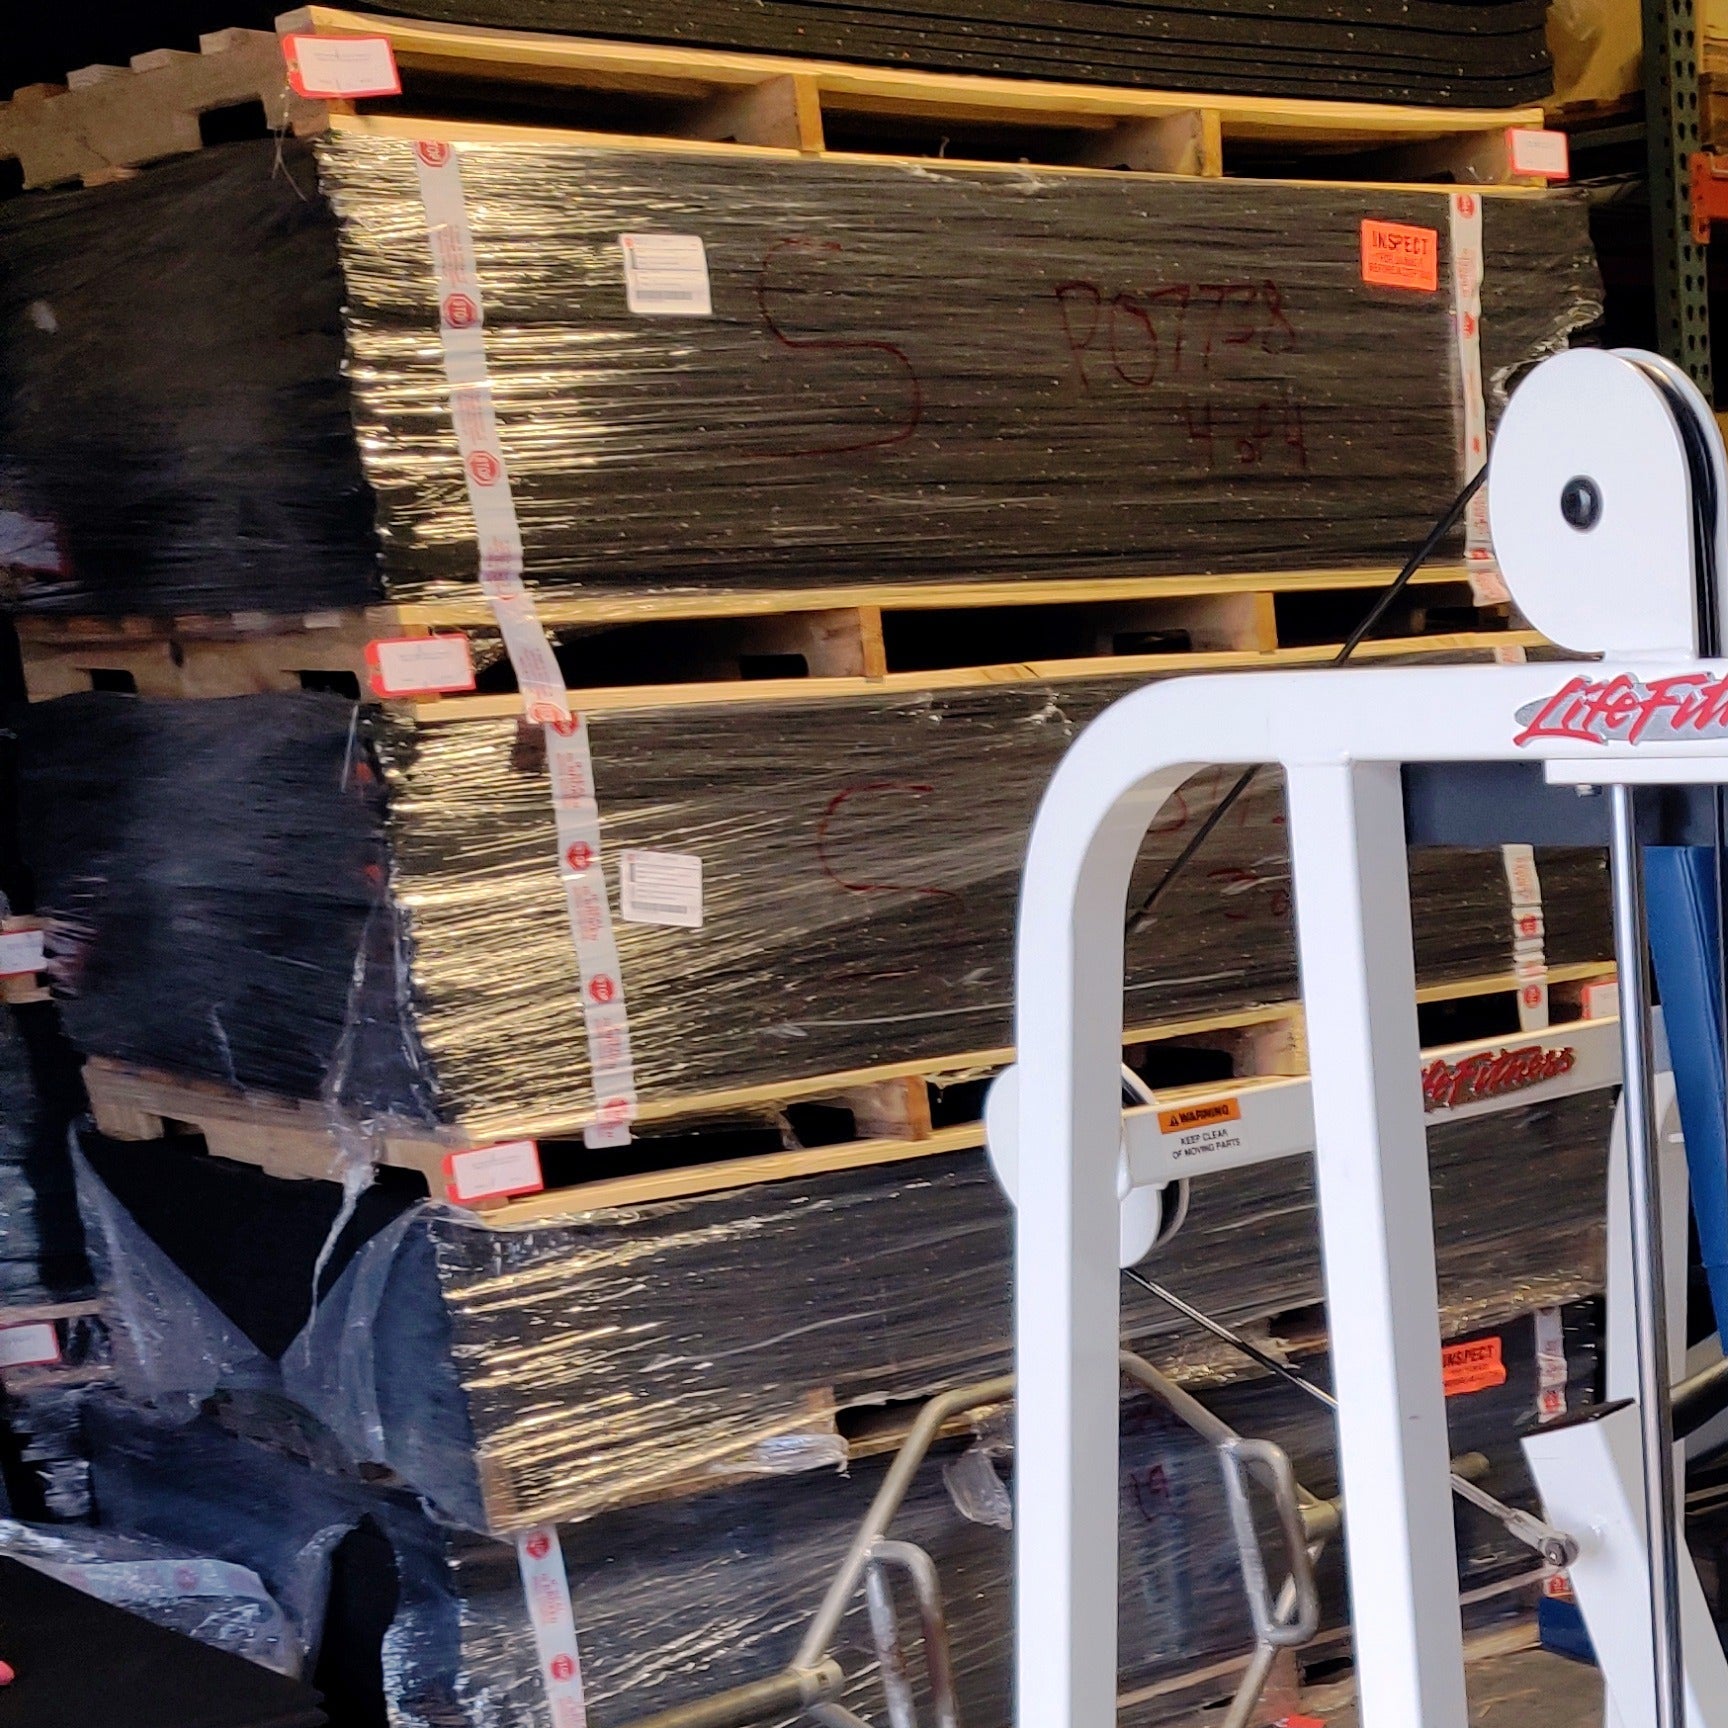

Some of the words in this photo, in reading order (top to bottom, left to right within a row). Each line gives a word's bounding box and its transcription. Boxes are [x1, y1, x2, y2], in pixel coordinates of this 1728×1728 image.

[1372, 230, 1429, 255] INSPECT
[1179, 1104, 1229, 1122] WARNING
[1180, 1133, 1201, 1146] KEEP
[1202, 1128, 1229, 1142] CLEAR
[1172, 1149, 1183, 1160] OF
[1184, 1142, 1215, 1157] MOVING
[1216, 1137, 1242, 1150] PARTS
